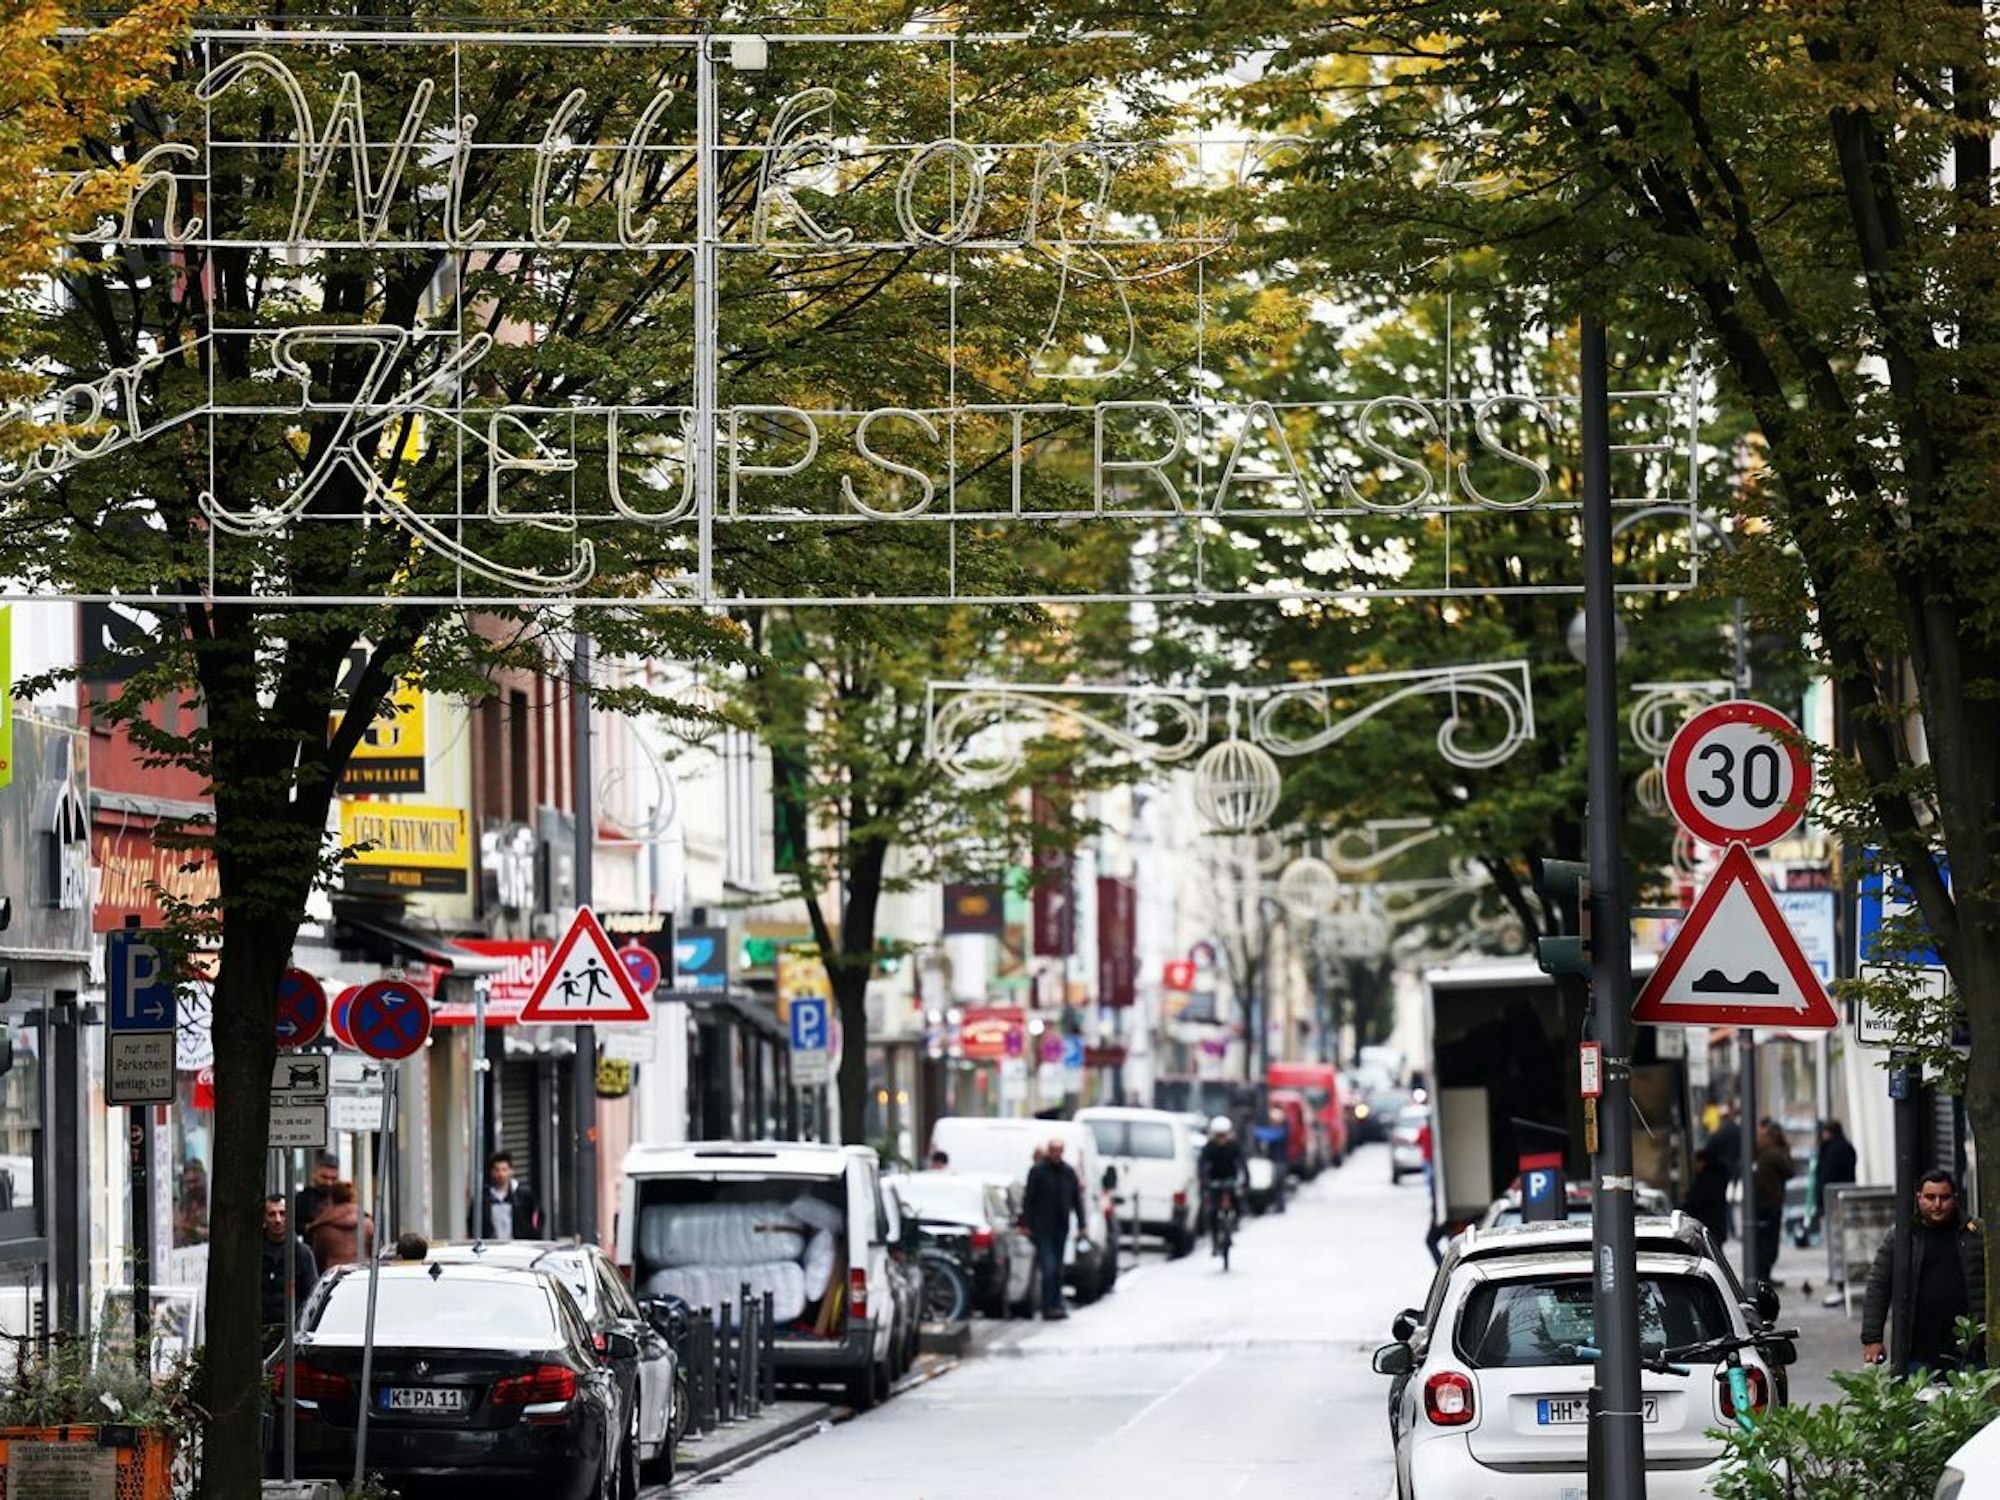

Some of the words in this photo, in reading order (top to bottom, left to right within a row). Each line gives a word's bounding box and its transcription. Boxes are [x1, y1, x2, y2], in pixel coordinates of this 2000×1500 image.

[1698, 744, 1779, 808] 30
[116, 1059, 169, 1071] Parkschein
[1530, 1171, 1547, 1198] P
[439, 1392, 458, 1407] 11
